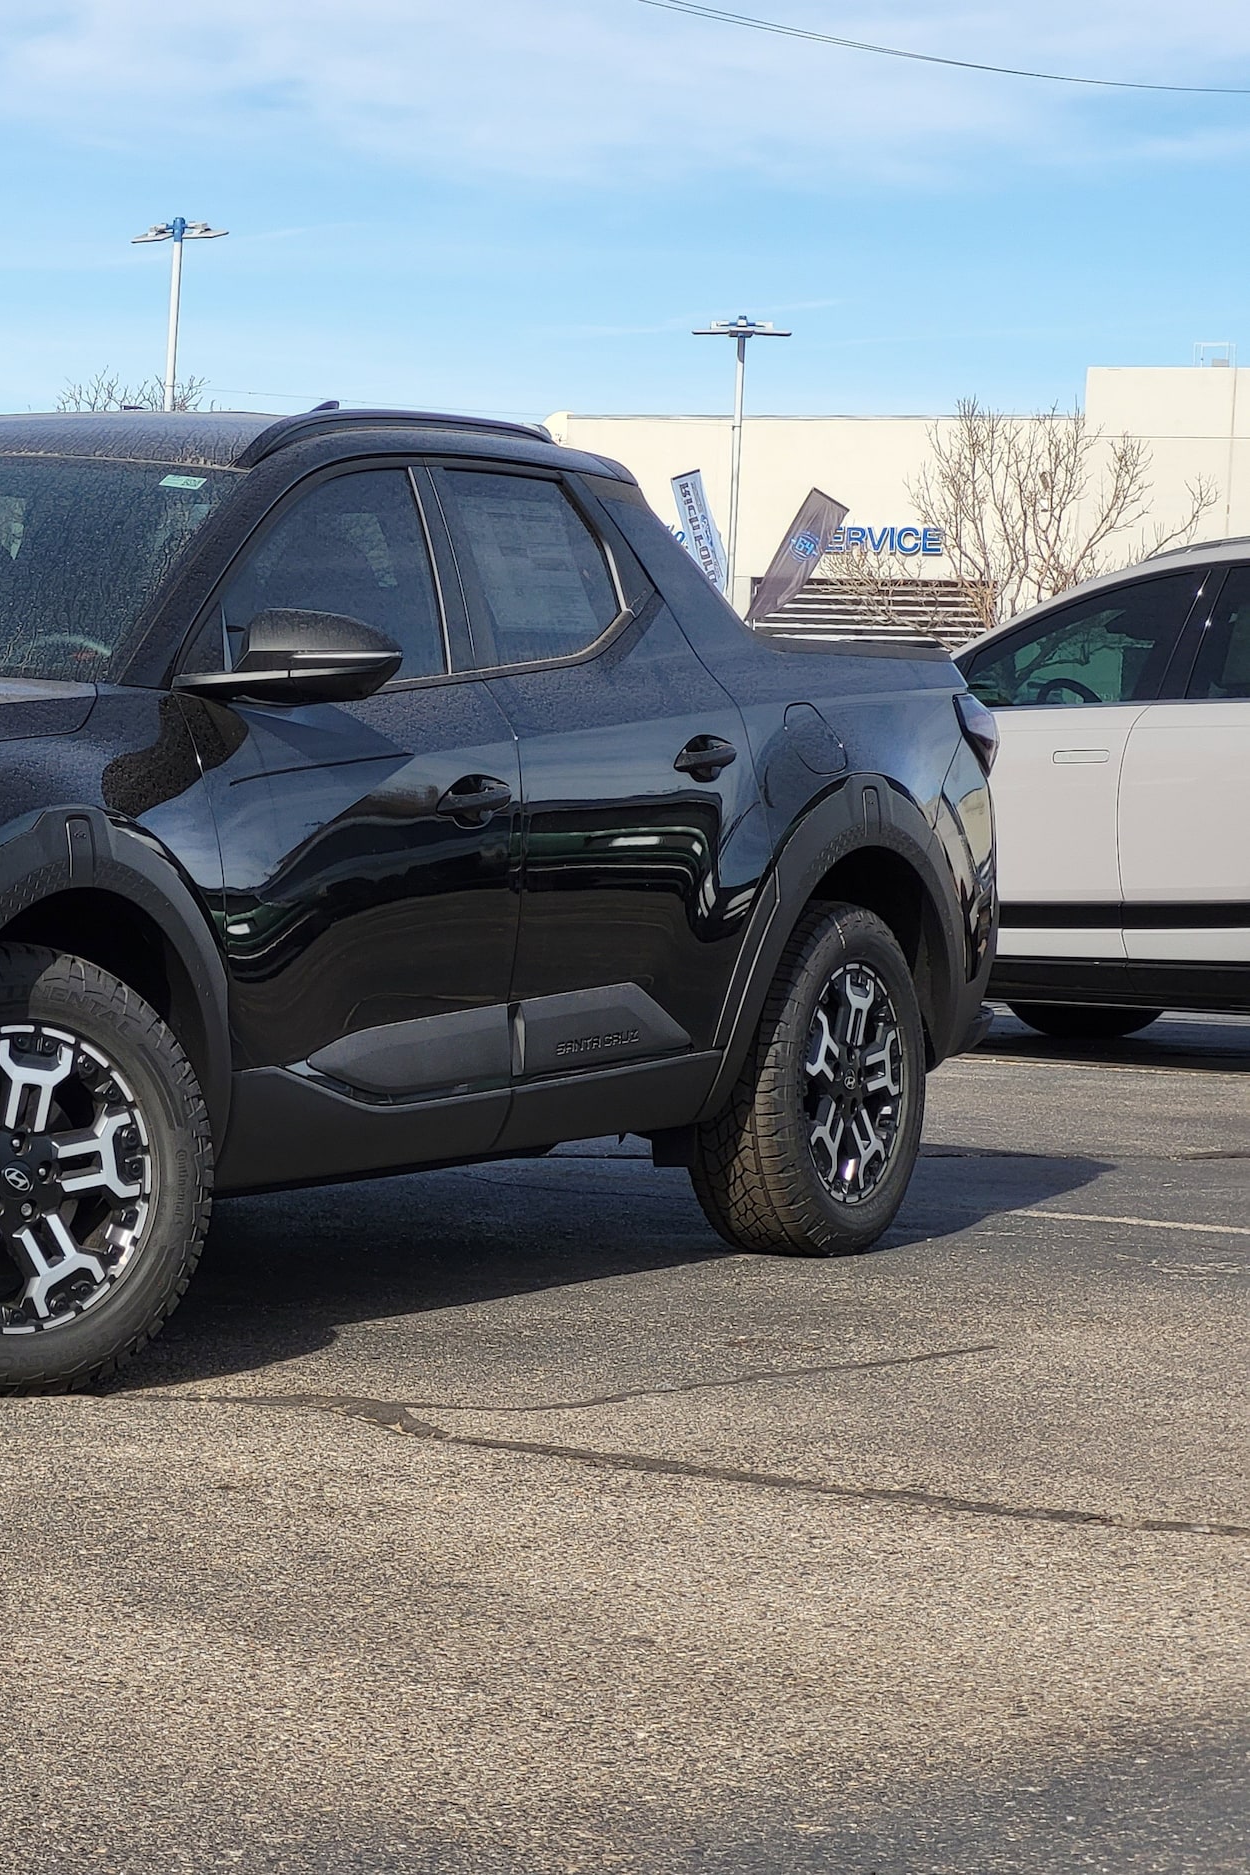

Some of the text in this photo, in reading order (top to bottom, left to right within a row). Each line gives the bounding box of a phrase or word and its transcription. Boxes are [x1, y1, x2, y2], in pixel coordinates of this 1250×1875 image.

[795, 538, 815, 555] 64
[825, 527, 943, 555] ERVICE
[556, 1028, 639, 1056] SANTA CRUZ
